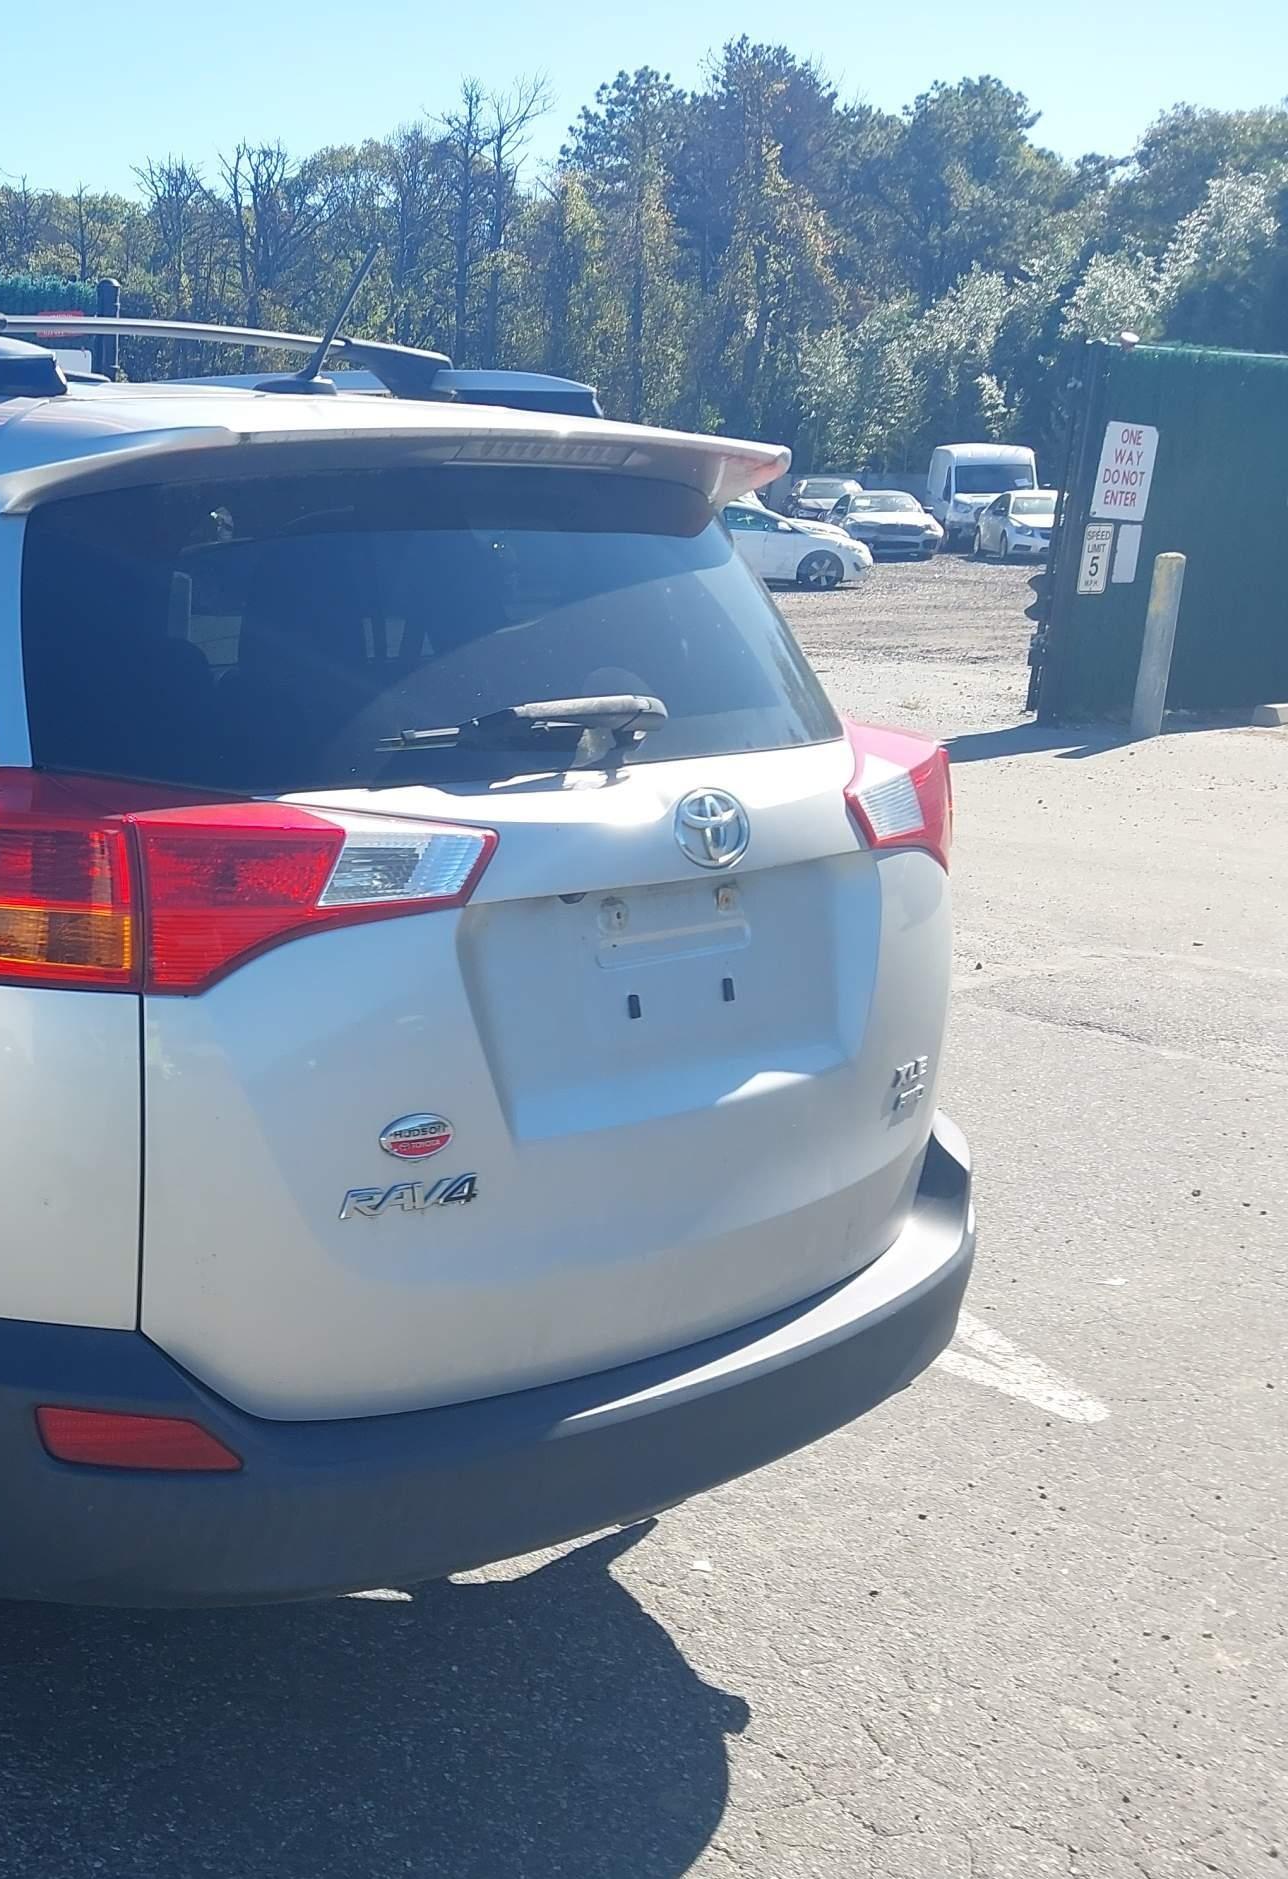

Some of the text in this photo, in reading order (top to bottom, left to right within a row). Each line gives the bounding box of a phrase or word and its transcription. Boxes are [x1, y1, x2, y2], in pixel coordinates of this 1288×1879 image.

[1121, 428, 1144, 446] ONE
[1114, 448, 1144, 466] WAY
[1102, 468, 1145, 488] DO NOT
[1103, 489, 1137, 507] ENTER
[1086, 530, 1111, 541] SPEED
[1087, 543, 1107, 553] LIMIT
[1088, 555, 1100, 577] 5
[338, 1172, 479, 1220] RAV4
